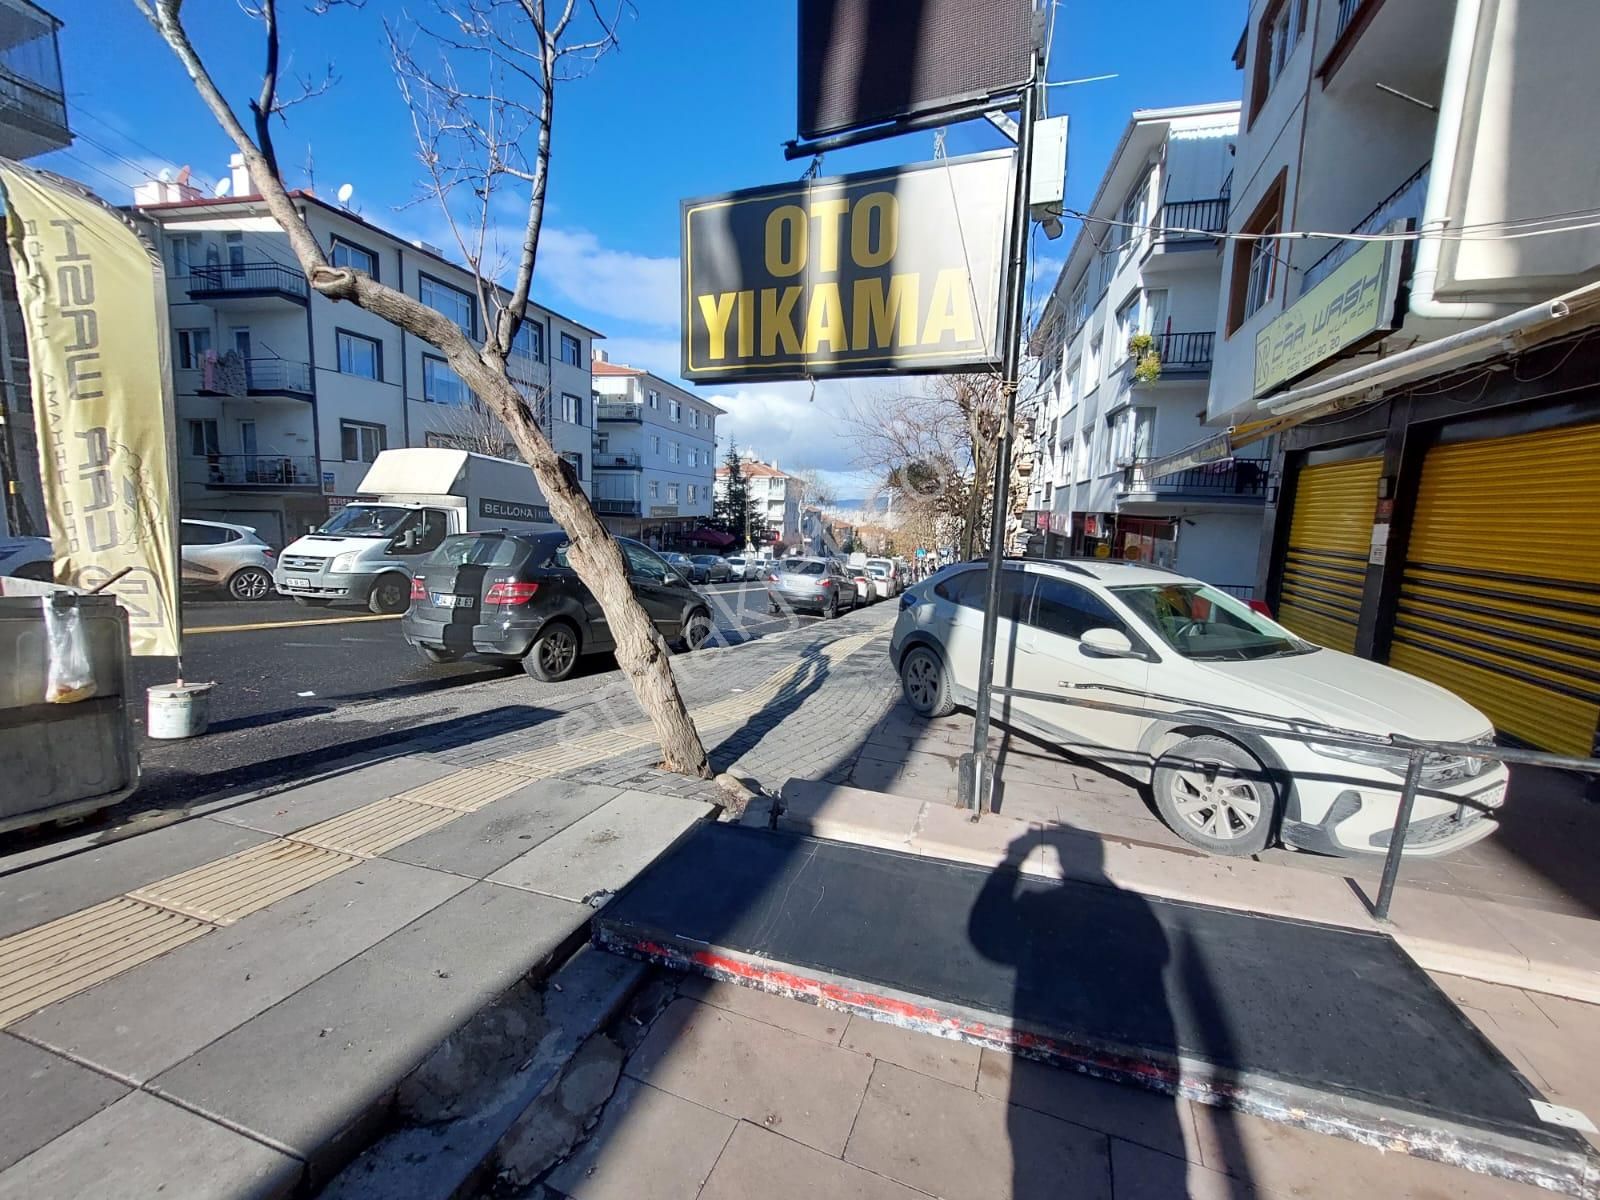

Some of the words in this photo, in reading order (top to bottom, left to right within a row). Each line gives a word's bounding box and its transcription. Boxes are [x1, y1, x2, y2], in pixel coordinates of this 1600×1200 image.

[765, 191, 900, 278] OTO
[698, 268, 976, 360] YIKAMA
[1272, 322, 1306, 363] CAR
[1312, 264, 1383, 336] WASH
[484, 503, 533, 518] BELLONA
